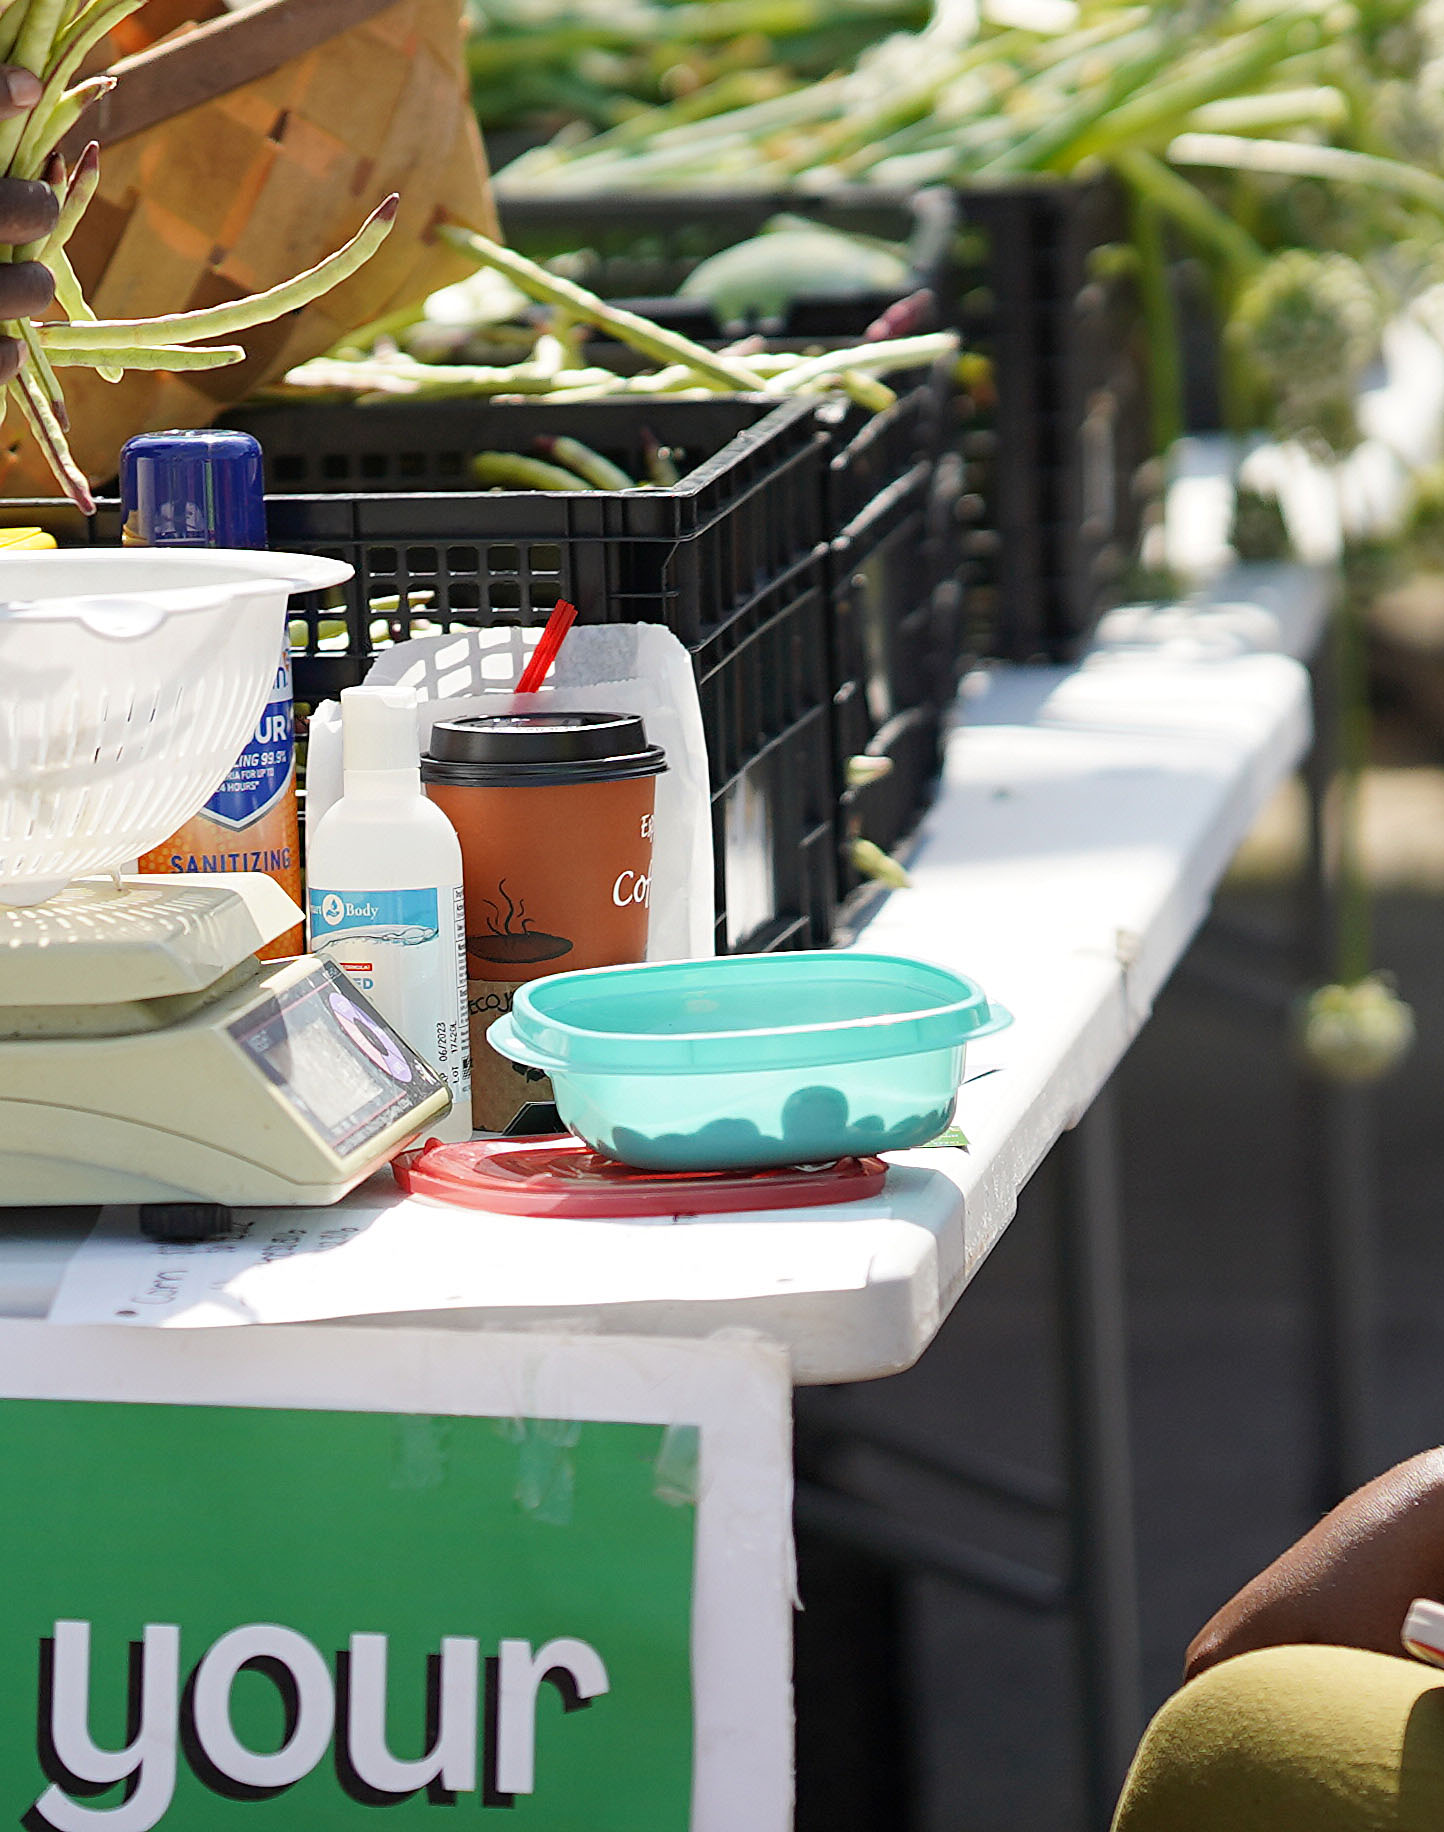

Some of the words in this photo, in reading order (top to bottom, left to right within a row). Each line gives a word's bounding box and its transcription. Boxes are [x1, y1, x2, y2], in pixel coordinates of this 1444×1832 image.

[170, 848, 290, 873] SANITIZING
[345, 902, 379, 920] Body
[437, 1021, 448, 1062] 06/2023
[452, 1066, 460, 1084] LOT
[20, 1619, 611, 1832] your
